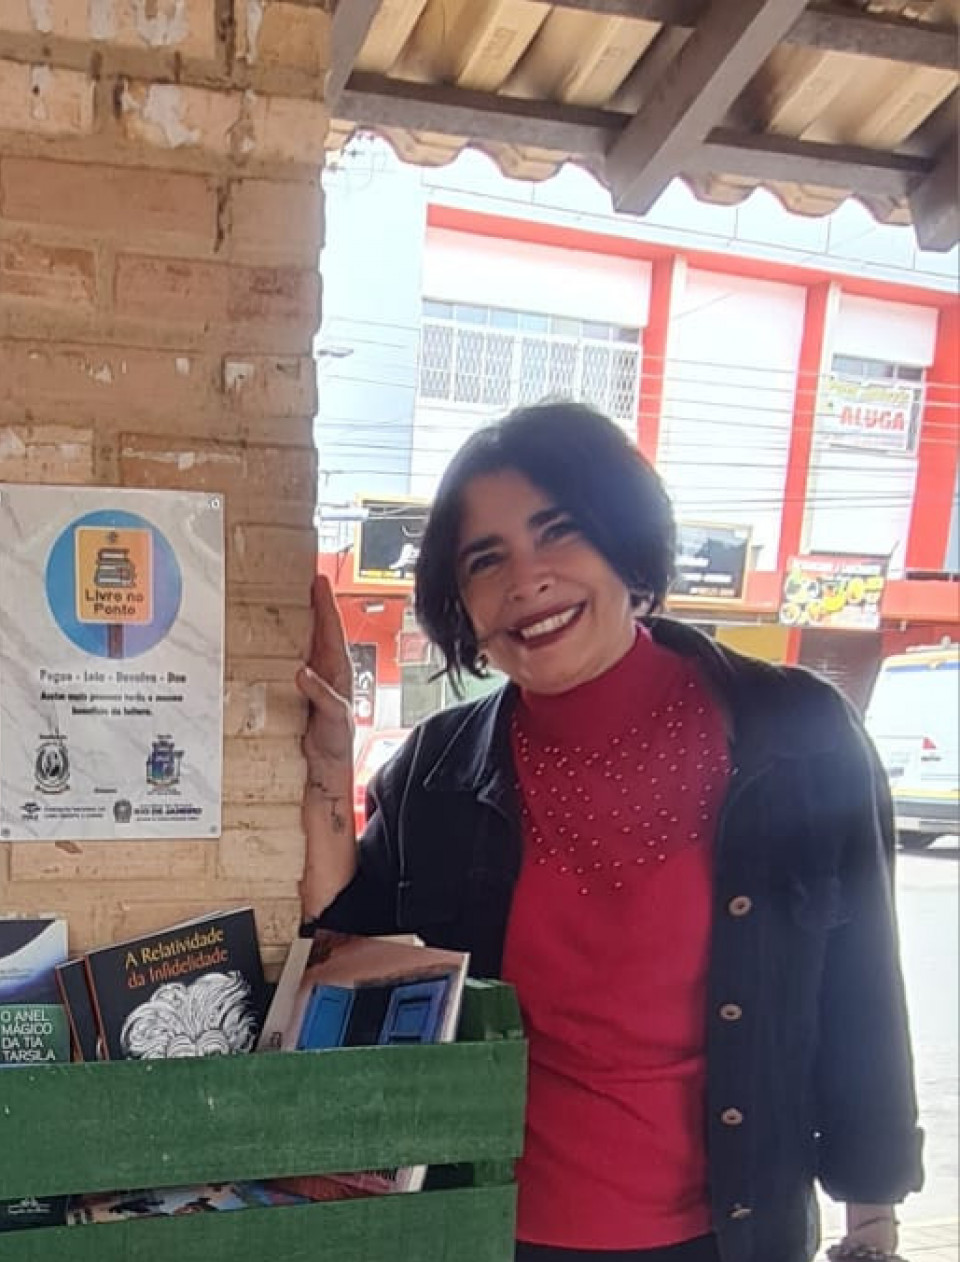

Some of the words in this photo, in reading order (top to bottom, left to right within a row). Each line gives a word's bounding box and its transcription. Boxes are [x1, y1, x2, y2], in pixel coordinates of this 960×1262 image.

[840, 406, 905, 432] ALUGA
[93, 602, 136, 615] Ponto
[125, 951, 138, 970] A
[141, 926, 225, 964] Relatividade
[127, 971, 146, 989] da
[148, 945, 228, 983] Infidelidade
[0, 1010, 11, 1023] O
[14, 1008, 51, 1022] ANEL
[0, 1020, 53, 1036] MÁGICO
[1, 1037, 21, 1050] DA
[24, 1036, 45, 1049] TIA
[0, 1049, 56, 1062] TARSILA
